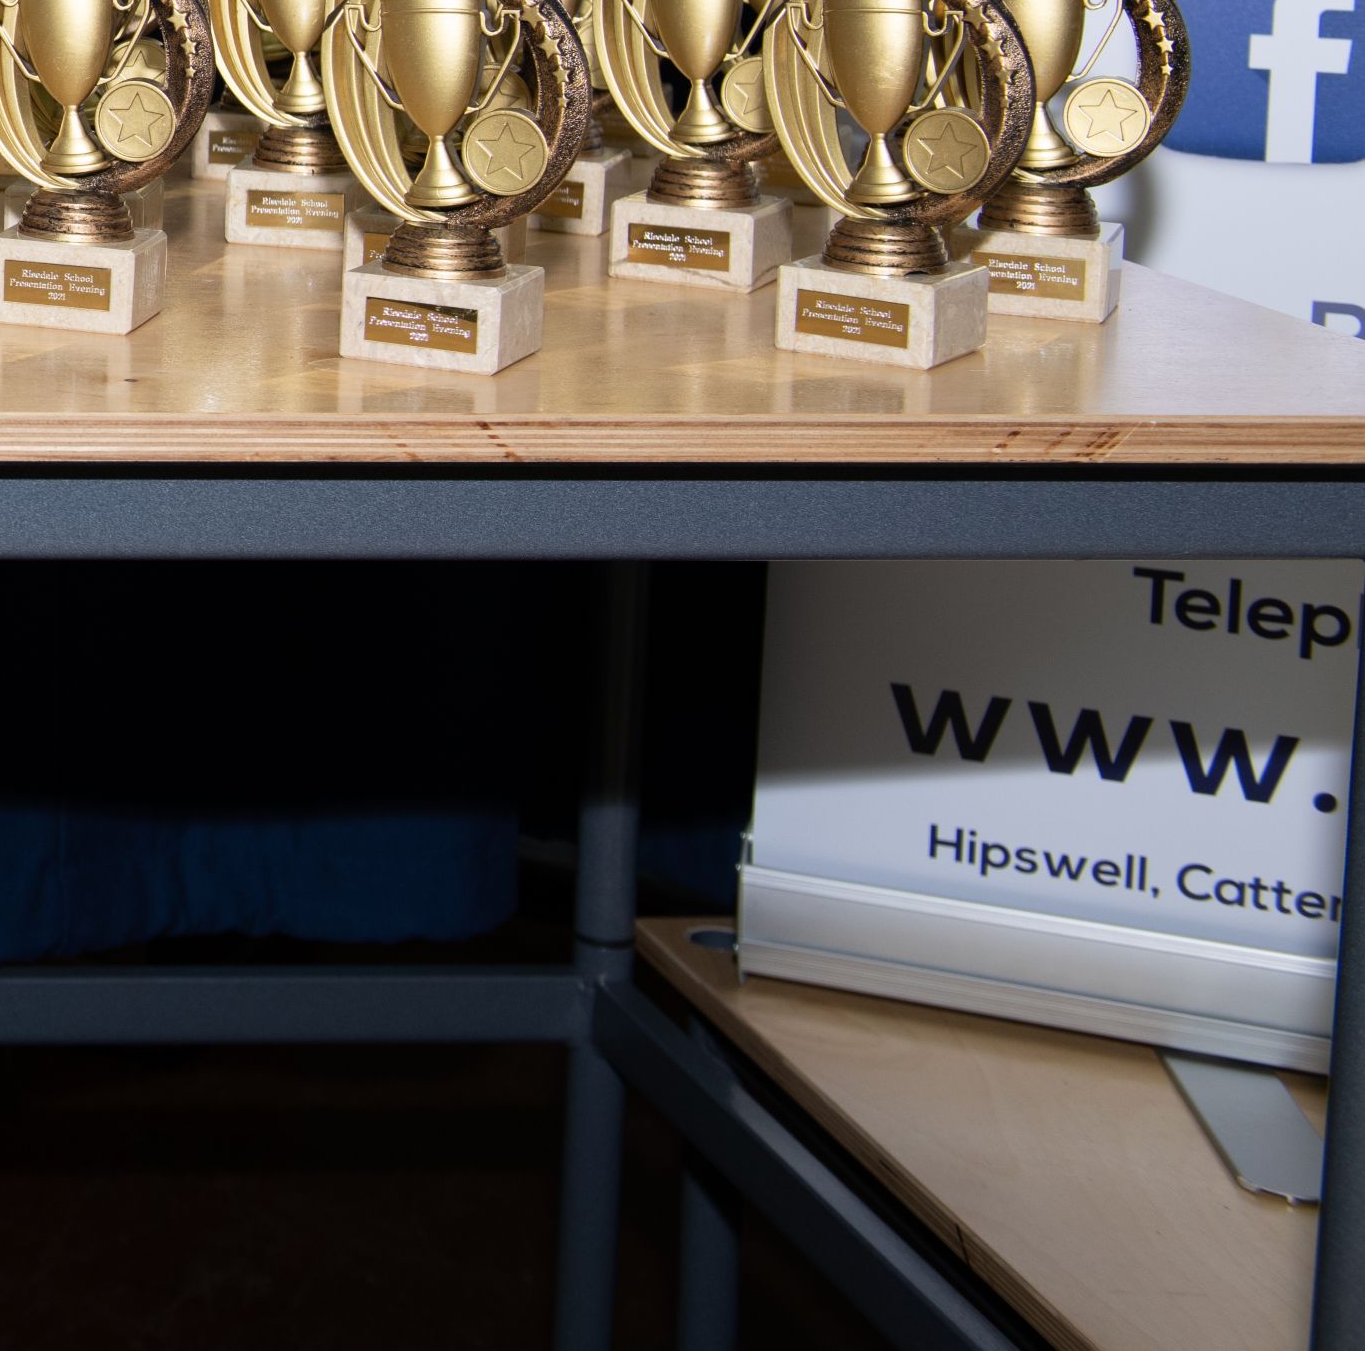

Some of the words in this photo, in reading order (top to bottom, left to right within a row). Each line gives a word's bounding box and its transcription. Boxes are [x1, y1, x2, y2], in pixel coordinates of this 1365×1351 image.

[262, 197, 296, 206] Risedale
[301, 199, 327, 207] School
[251, 206, 300, 215] Presentation
[306, 209, 338, 218] Evening
[644, 232, 679, 242] Risedale
[685, 235, 713, 245] School
[633, 240, 683, 252] Presentation
[689, 245, 725, 257] Evening
[989, 259, 1029, 270] Risedale
[1034, 263, 1065, 273] School
[22, 269, 59, 280] Risedale
[64, 273, 93, 283] School
[989, 270, 1032, 280] sentation
[1039, 273, 1078, 285] Evening
[10, 278, 63, 290] Presentation
[70, 284, 105, 295] Evening
[1016, 281, 1035, 290] 2021
[48, 292, 65, 300] 2021
[383, 307, 422, 319] Risedale
[427, 313, 458, 324] School
[816, 300, 854, 313] Risedale
[860, 306, 891, 318] School
[369, 316, 426, 331] Presentation
[433, 324, 470, 338] Evening
[802, 308, 858, 323] Presentation
[865, 317, 903, 331] Evening
[1133, 566, 1363, 659] Telep
[928, 823, 1160, 898] Hipswell,
